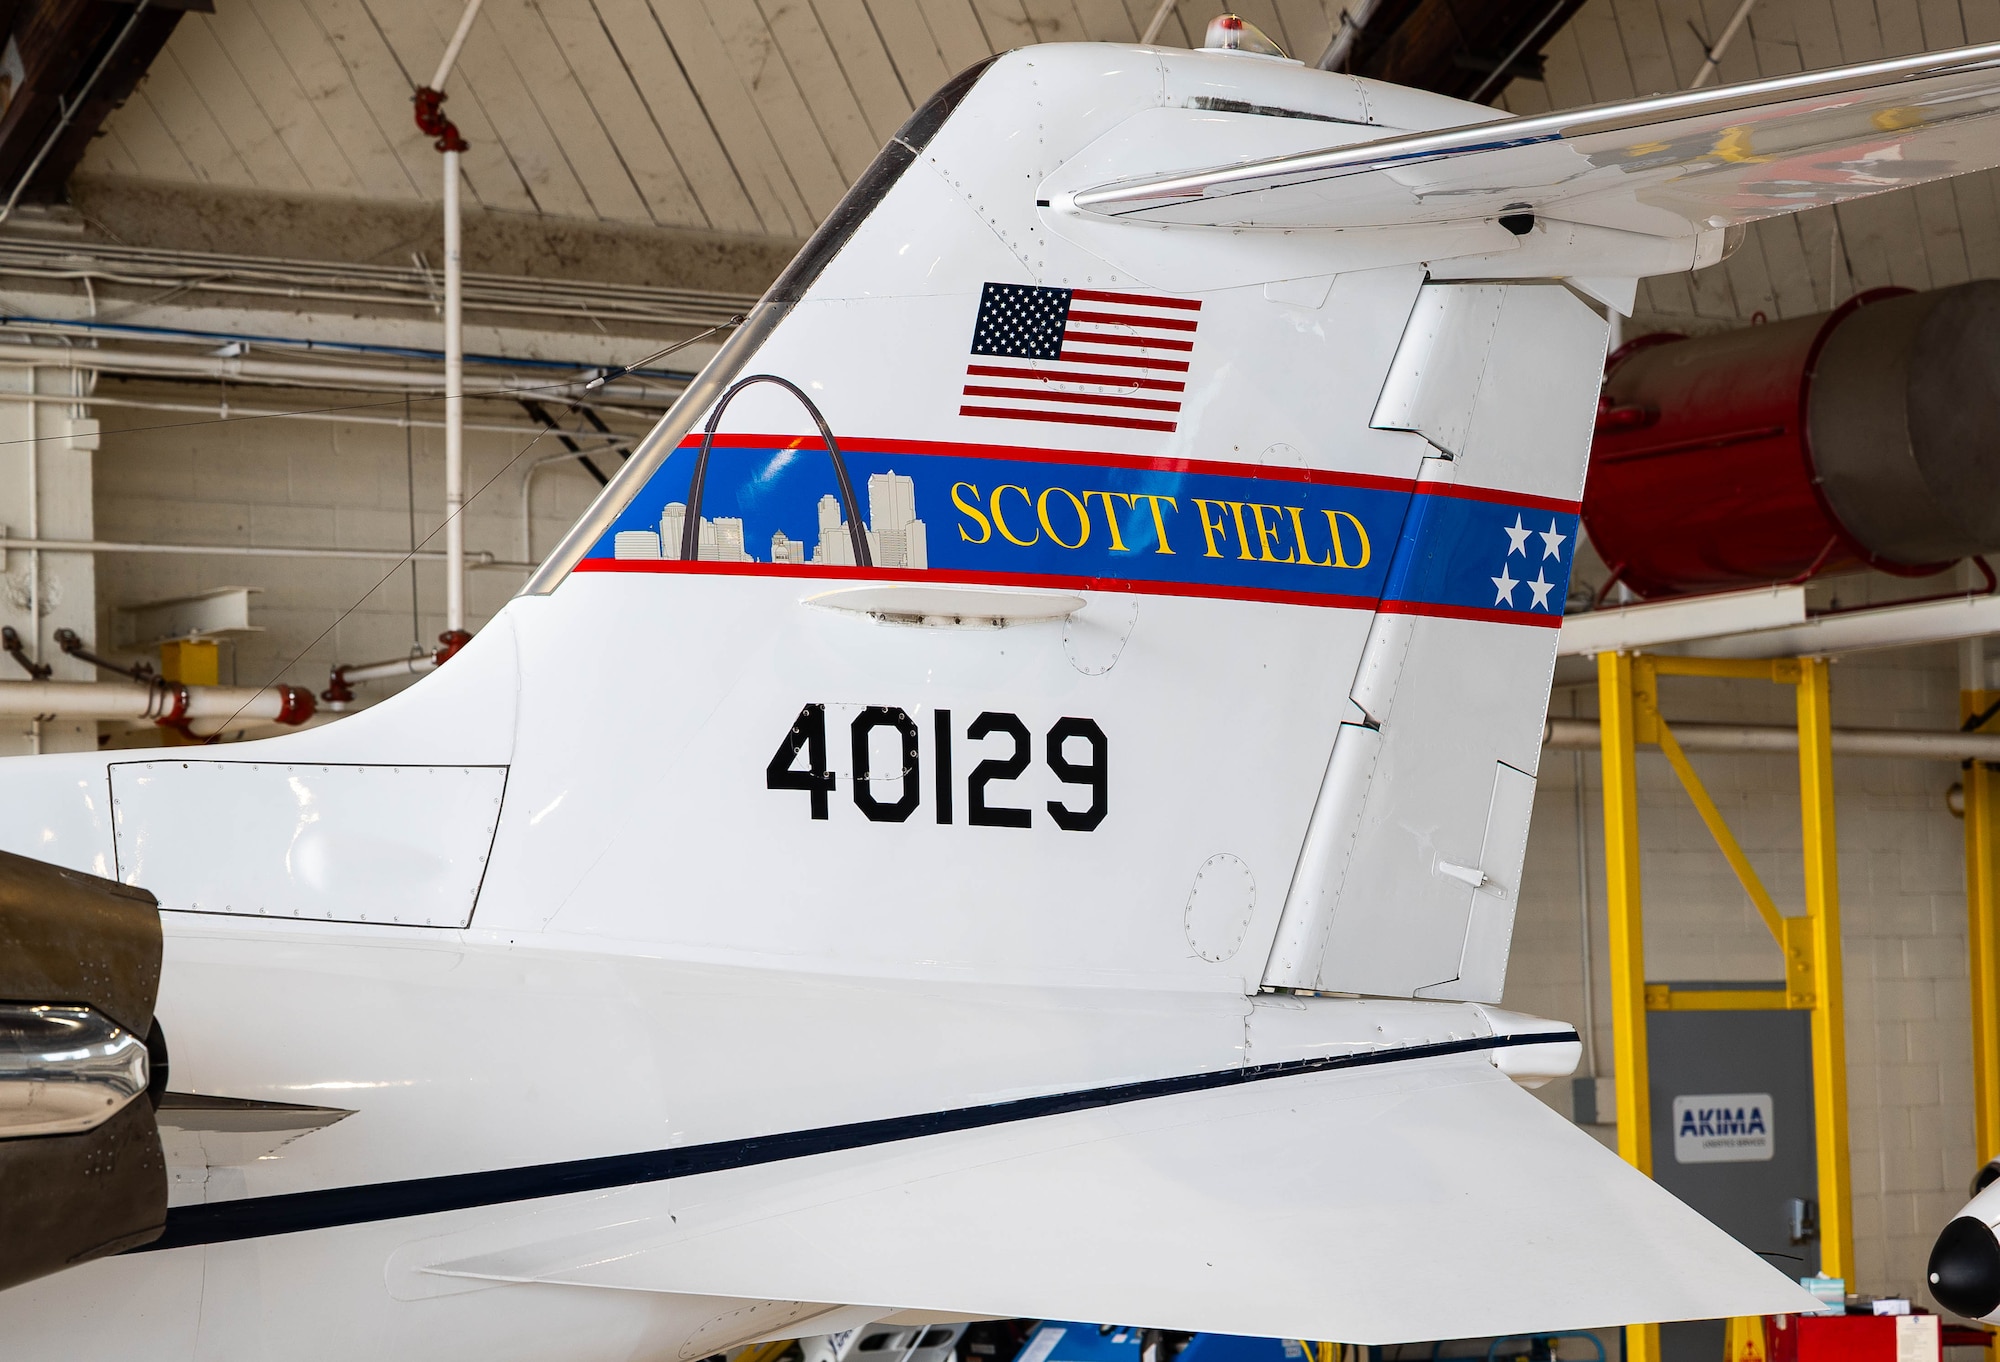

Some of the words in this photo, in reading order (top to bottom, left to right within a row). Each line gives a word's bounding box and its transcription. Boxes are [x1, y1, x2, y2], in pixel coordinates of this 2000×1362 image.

[950, 482, 1179, 555] SCOTT
[1191, 498, 1371, 570] FIELD
[766, 703, 1108, 832] 40129
[1680, 1107, 1766, 1137] AKIMA
